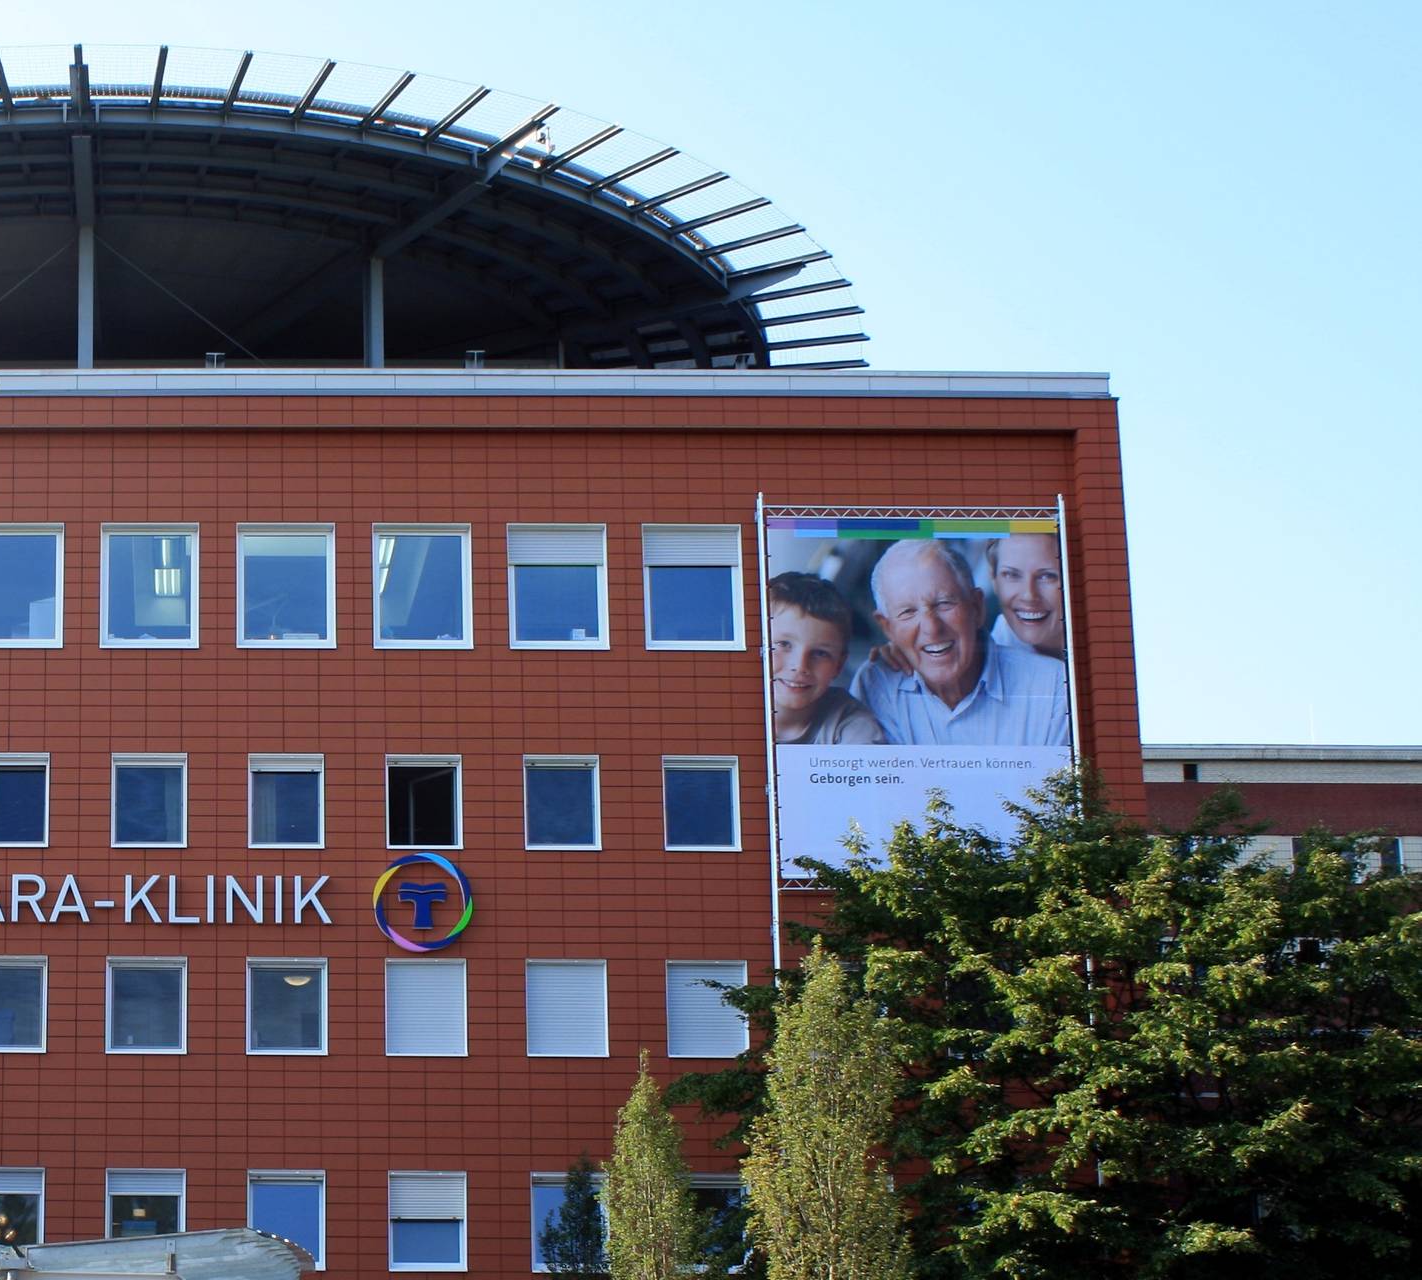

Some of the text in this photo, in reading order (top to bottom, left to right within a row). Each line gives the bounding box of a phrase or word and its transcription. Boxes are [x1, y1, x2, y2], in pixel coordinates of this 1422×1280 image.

[809, 757, 1036, 771] Umsorgt werden. Vertrauen können.
[809, 773, 904, 787] Geborgen sein.
